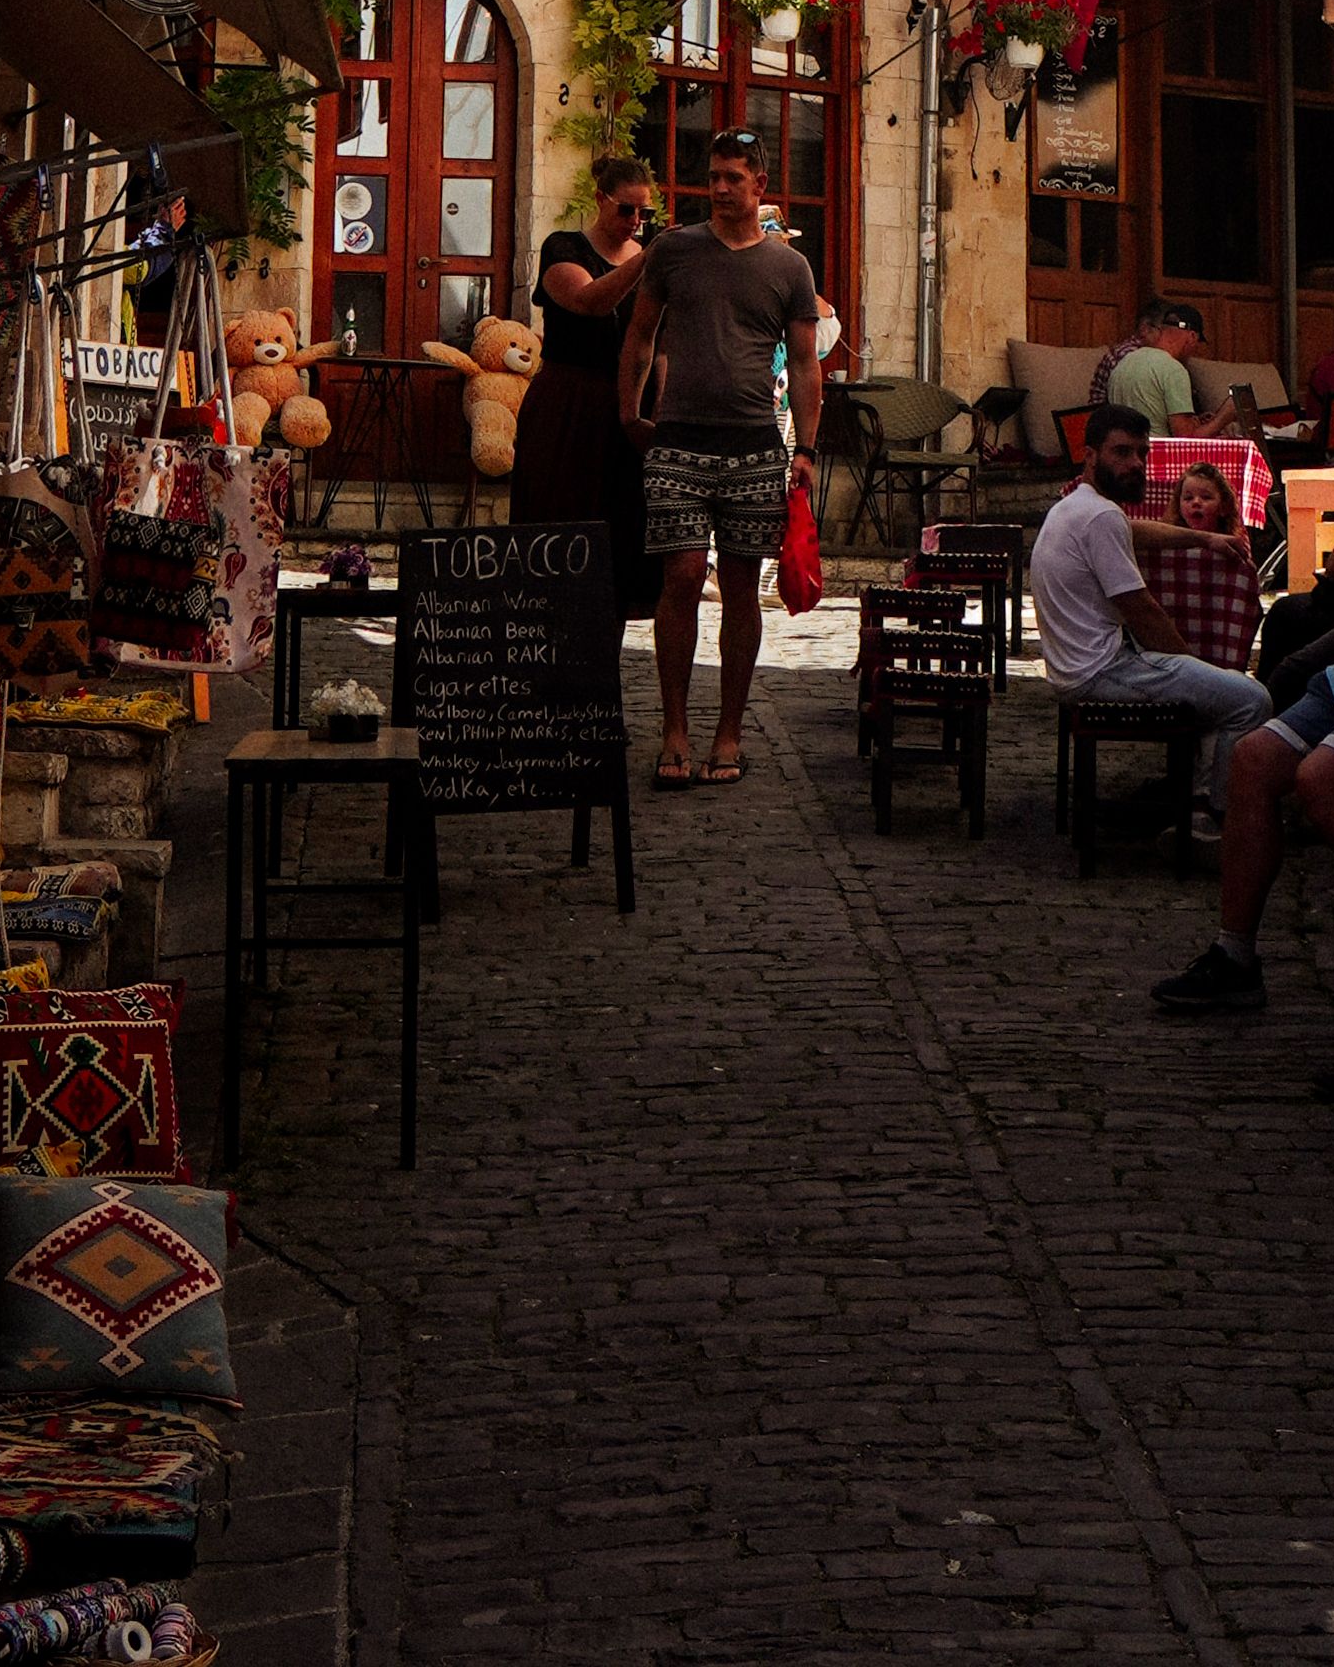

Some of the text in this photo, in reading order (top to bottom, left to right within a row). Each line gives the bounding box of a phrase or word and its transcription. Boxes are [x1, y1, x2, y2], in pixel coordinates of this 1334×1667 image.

[420, 533, 590, 579] TOBACCO
[416, 590, 490, 615] Albanian
[414, 618, 491, 642] Albanian
[416, 647, 493, 664] Albanian
[507, 644, 556, 664] RAKI
[413, 673, 532, 708] Cigarettes
